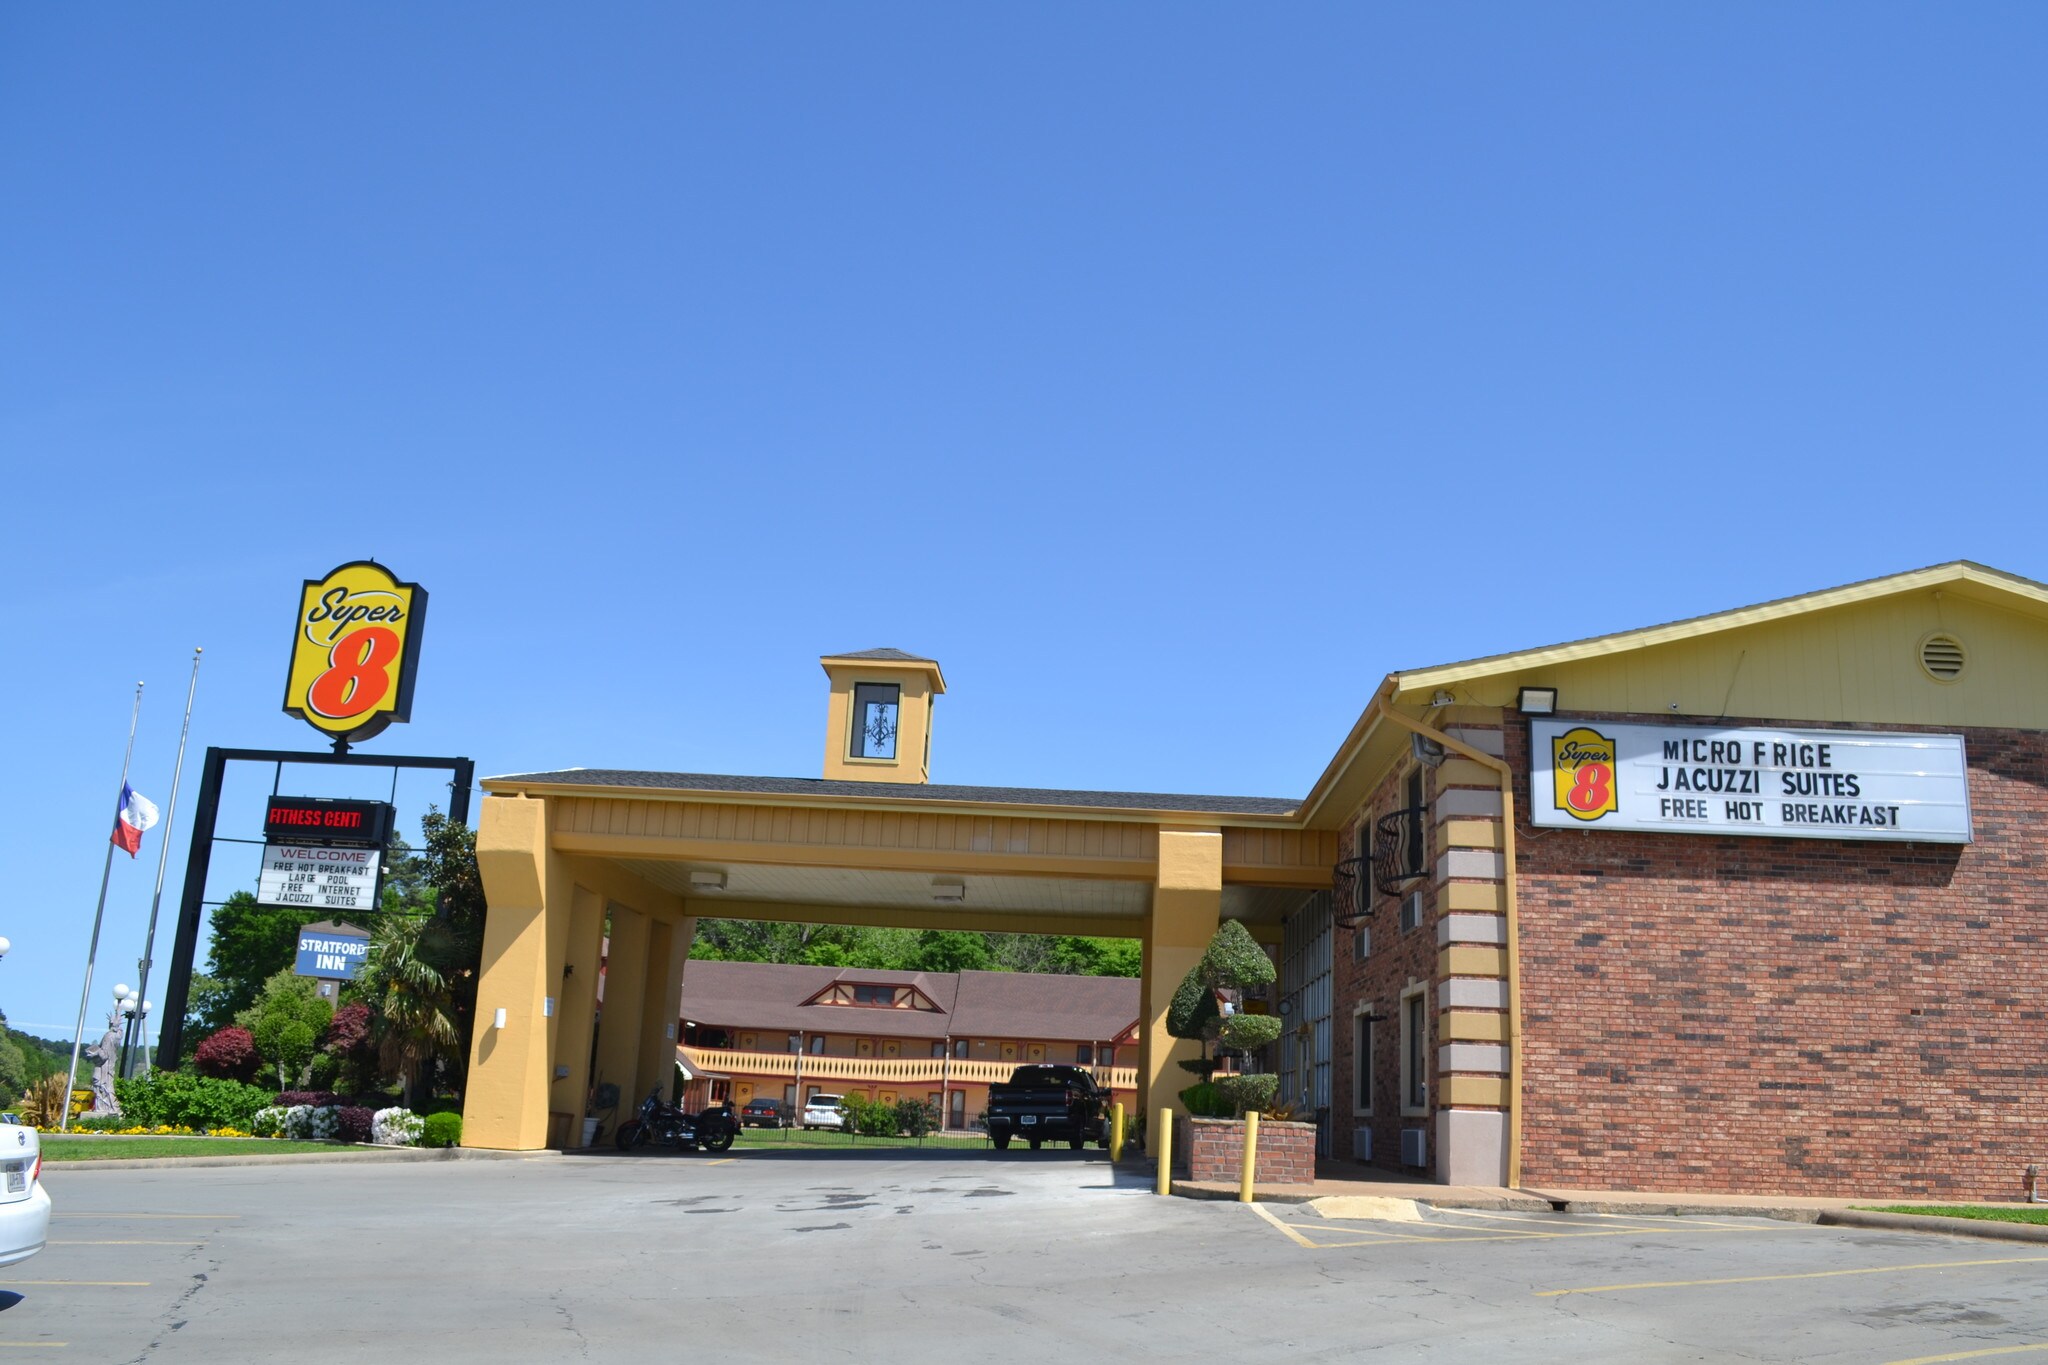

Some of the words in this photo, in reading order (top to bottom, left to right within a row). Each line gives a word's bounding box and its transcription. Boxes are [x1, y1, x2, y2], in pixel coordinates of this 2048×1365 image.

[307, 587, 405, 641] Super
[307, 627, 400, 719] 8
[1558, 742, 1611, 770] Super
[1663, 739, 1742, 763] MICRO
[1752, 742, 1831, 767] FRIGE
[1566, 762, 1612, 812] 8
[1656, 768, 1759, 794] JACUZZI
[1782, 772, 1861, 797] SUITES
[1661, 798, 1708, 819] FREE
[1725, 801, 1764, 822] HOT
[1782, 803, 1899, 826] BREAKFAST
[280, 848, 367, 863] WELCOME
[273, 862, 294, 872] FREE
[298, 863, 314, 873] HOT
[318, 865, 370, 876] BREAKFAST
[289, 875, 316, 884] LARGE
[327, 877, 349, 885] POOL
[276, 894, 313, 904] JACUZZI
[325, 896, 357, 906] SUITES
[281, 885, 304, 893] FREE
[318, 887, 361, 896] INTERNET
[300, 938, 366, 956] STRATFORD
[315, 954, 346, 971] INN
